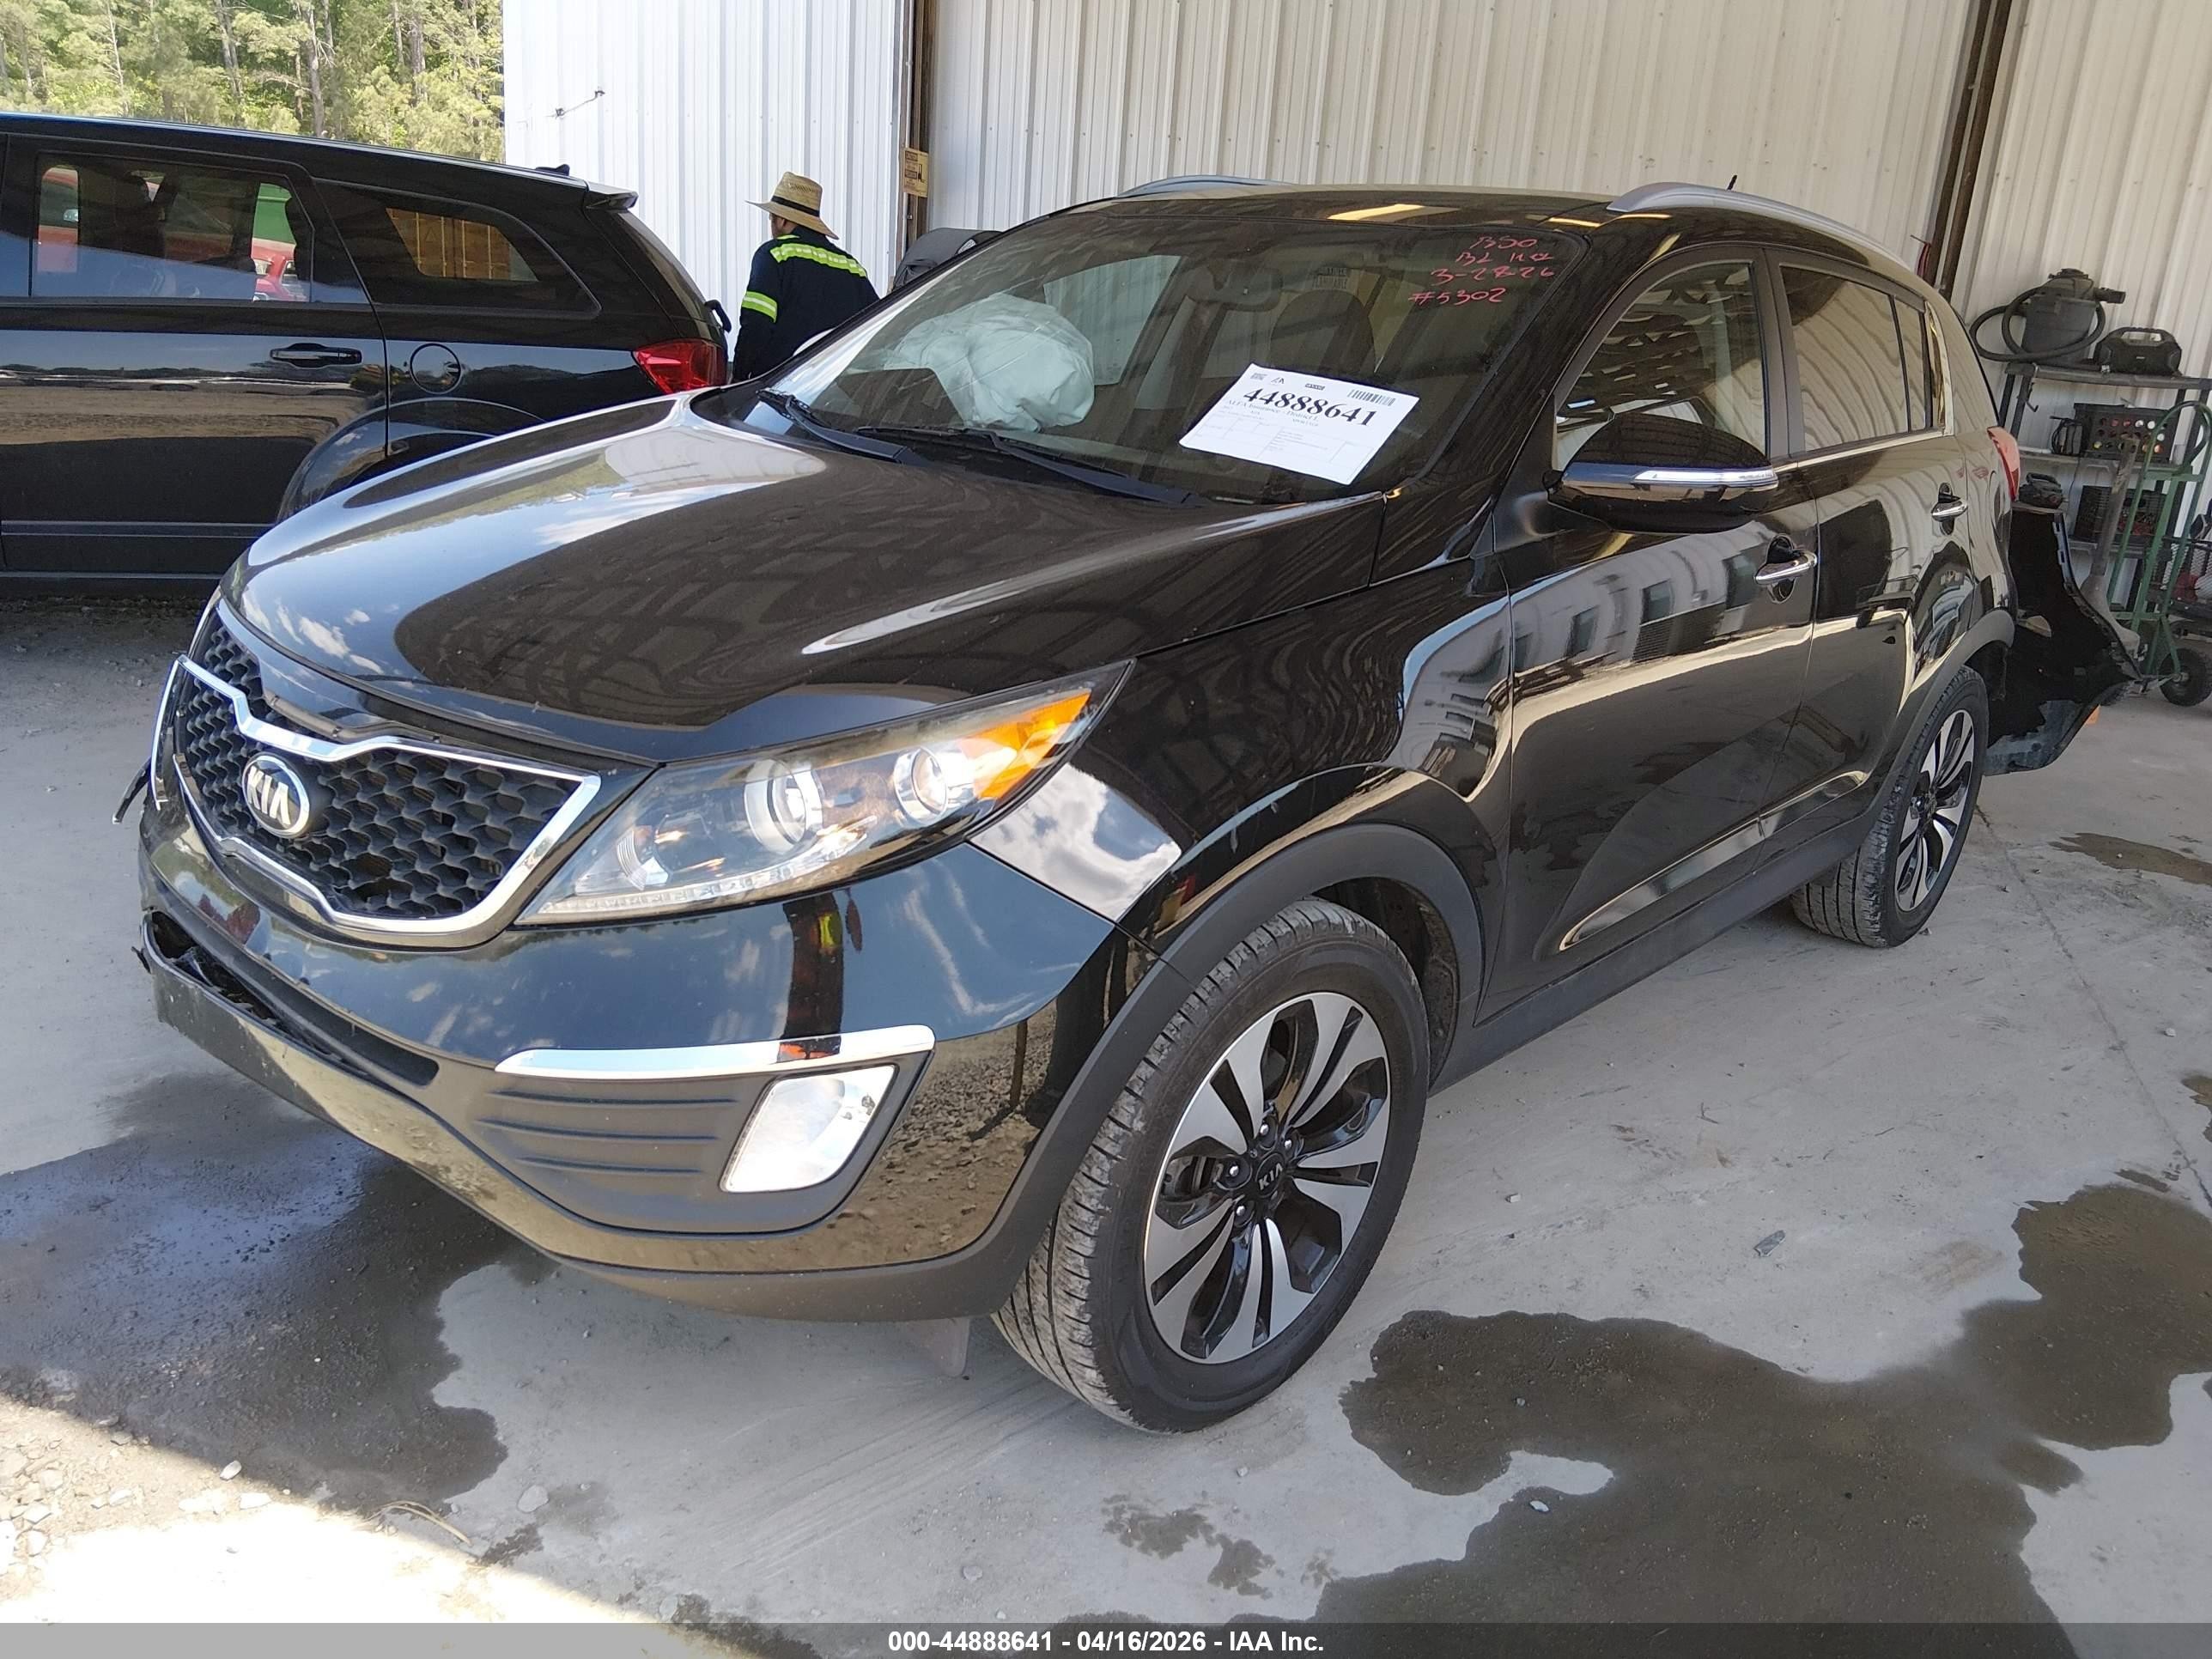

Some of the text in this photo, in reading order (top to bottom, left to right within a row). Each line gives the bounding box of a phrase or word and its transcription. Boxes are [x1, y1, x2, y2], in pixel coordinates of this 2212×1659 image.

[1408, 288, 1506, 306] #5302
[1243, 388, 1377, 426] 44888641
[246, 765, 292, 829] KIA
[1259, 1163, 1283, 1190] KIA
